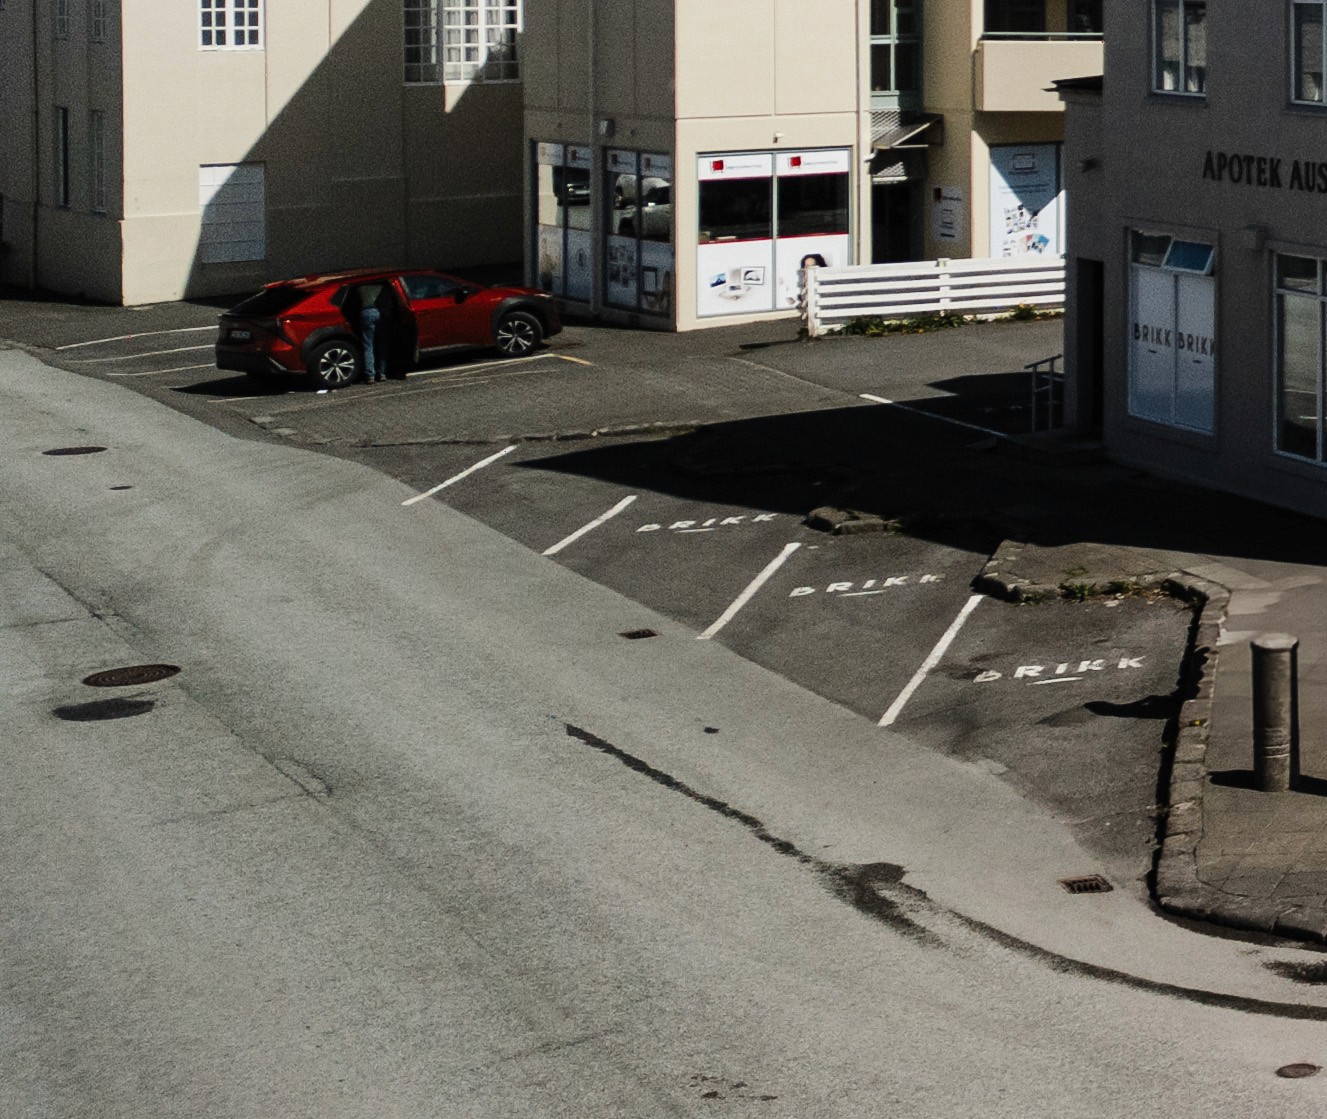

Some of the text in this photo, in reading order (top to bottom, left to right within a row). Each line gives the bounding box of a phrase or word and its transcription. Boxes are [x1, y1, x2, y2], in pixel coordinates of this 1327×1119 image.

[1203, 150, 1282, 188] APOTEK
[1133, 323, 1171, 347] BRIKK
[788, 574, 946, 597] BRIKK
[973, 655, 1146, 683] BRIKK
